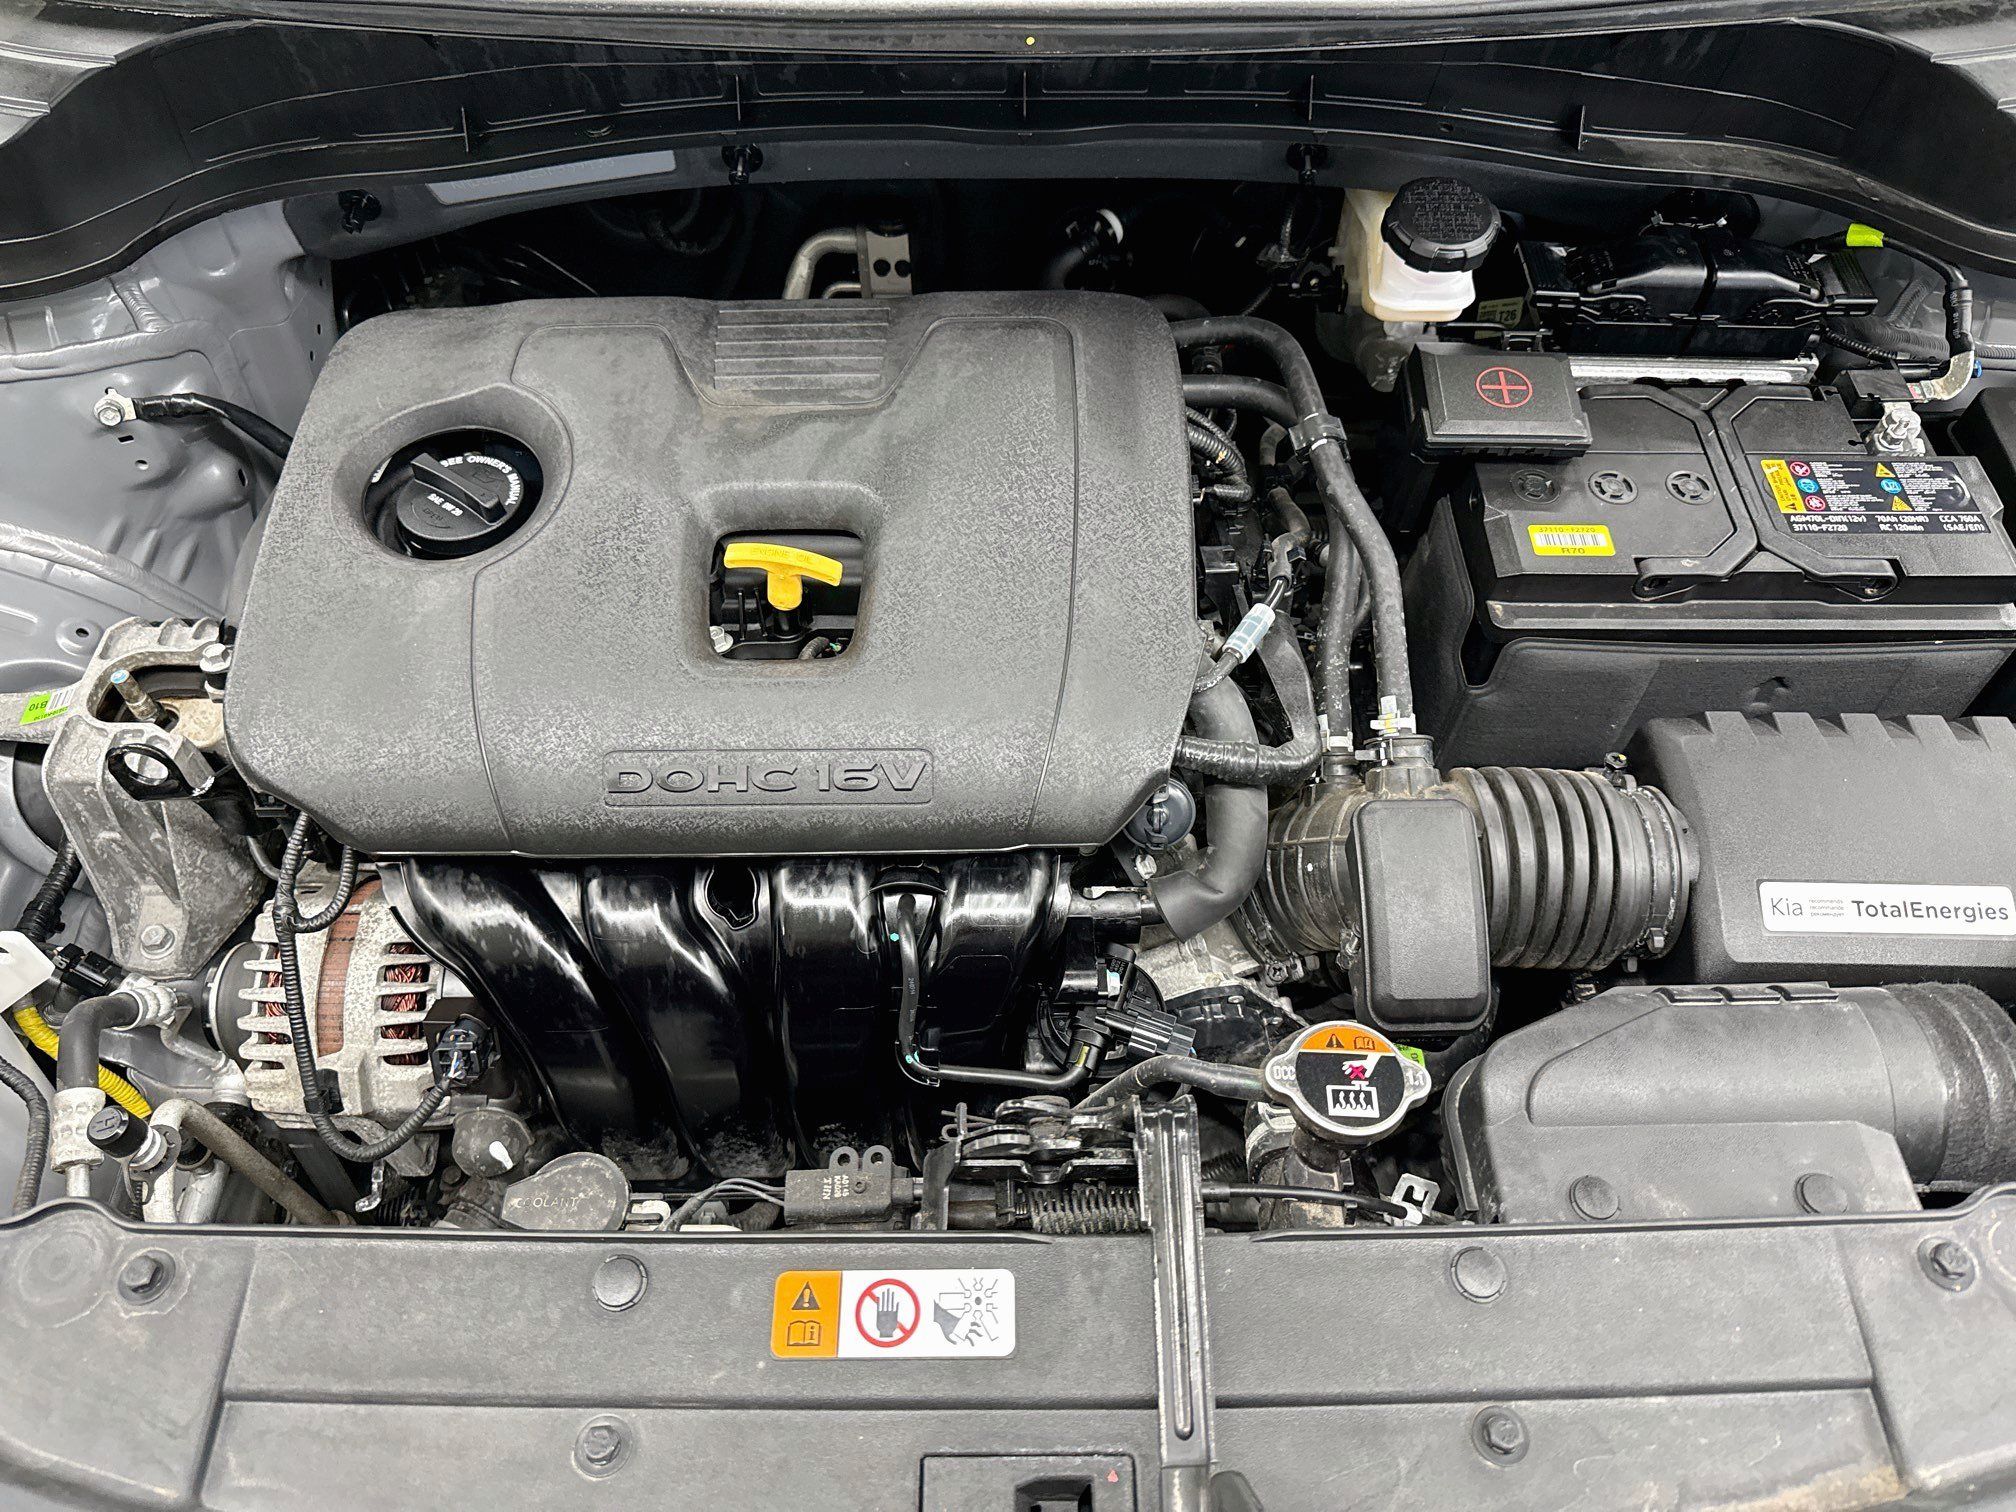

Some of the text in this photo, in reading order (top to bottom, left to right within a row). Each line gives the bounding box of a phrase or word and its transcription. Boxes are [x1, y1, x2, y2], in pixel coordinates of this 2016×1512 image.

[439, 456, 464, 468] SEE
[506, 472, 521, 505] MANUAL
[427, 493, 443, 505] SAE
[1938, 515, 1957, 523] CCA
[1561, 547, 1586, 555] R70
[606, 760, 928, 794] DOHC 16V
[1770, 897, 2010, 923] Kia TotalEnergies
[514, 1197, 579, 1209] COOLANT
